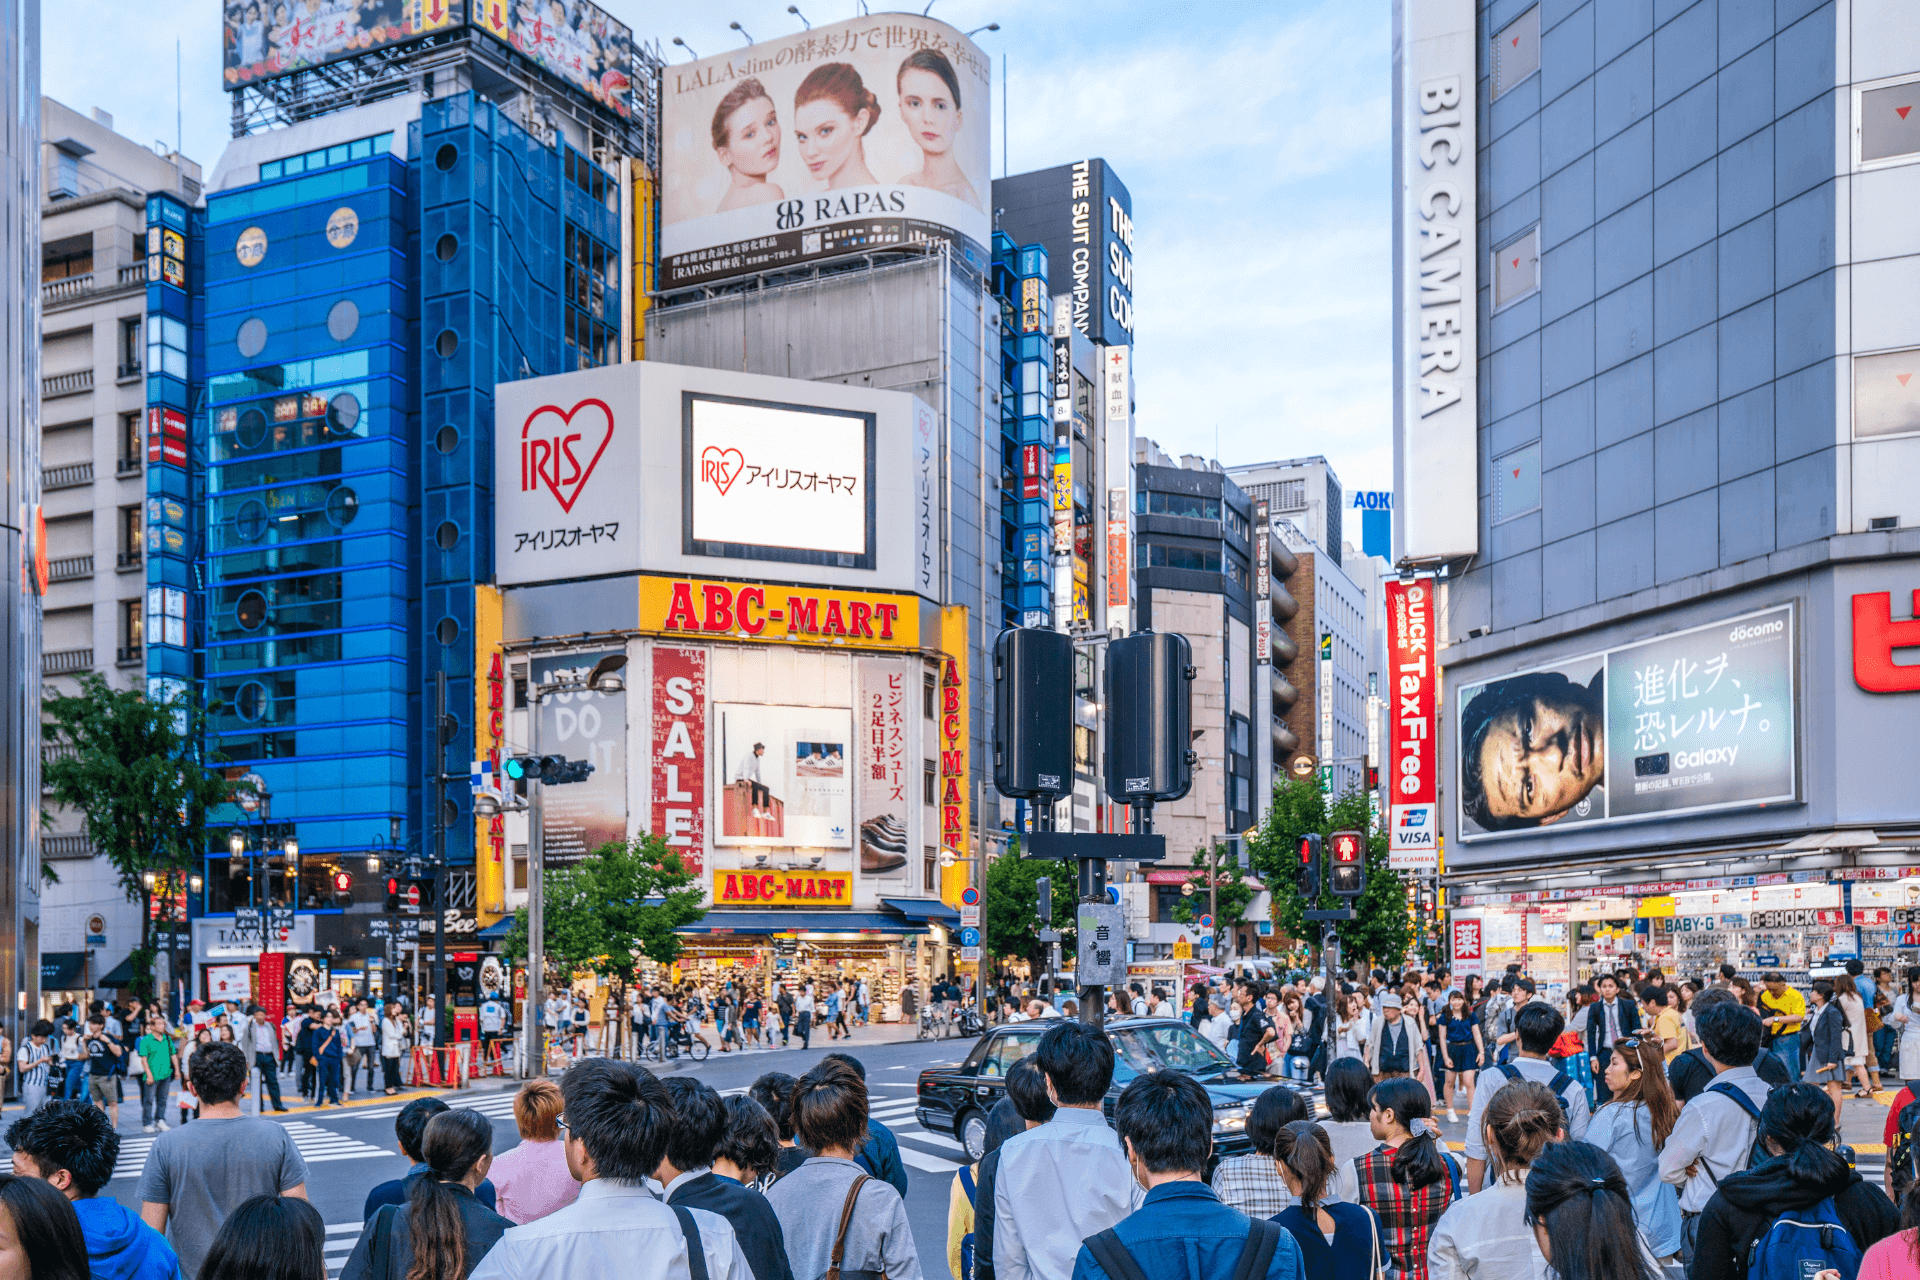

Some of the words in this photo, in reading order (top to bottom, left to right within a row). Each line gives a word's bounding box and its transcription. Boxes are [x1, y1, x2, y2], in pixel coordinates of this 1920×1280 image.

[1419, 75, 1461, 171] BIC
[1072, 159, 1089, 200] THE
[815, 190, 905, 221] RAPAS
[1072, 202, 1090, 245] SUIT
[1419, 181, 1462, 420] CAMERA
[1111, 372, 1123, 400] 献血
[1110, 405, 1123, 414] 9F
[521, 433, 582, 492] IRIS
[701, 458, 730, 485] IRIS
[746, 464, 857, 496] アイリスオーヤマ
[920, 447, 930, 590] アイリスオーヤマ
[1108, 522, 1126, 535] 本
[514, 522, 620, 554] アイリスオーヤマ
[664, 581, 899, 640] ABC-MART
[1407, 586, 1427, 655] QUICK
[1729, 619, 1784, 643] docomo
[1633, 652, 1741, 709] 進化ヲ、
[555, 704, 602, 742] DO
[871, 693, 887, 781] 2足目半額
[888, 672, 904, 802] ビジネスシューズ
[1399, 654, 1427, 795] TaxFree
[1633, 693, 1771, 751] 恐レルナ。
[489, 652, 504, 864] ABC-MRT
[662, 677, 697, 846] SALE
[941, 659, 963, 852] ABC-MART
[1674, 745, 1739, 770] Galaxy
[1398, 831, 1431, 844] VISA
[722, 874, 845, 901] ABC-MART
[1639, 883, 1659, 892] QUICK
[236, 909, 259, 918] MOA
[272, 909, 292, 918] モア
[370, 920, 390, 929] MOA
[1665, 916, 1714, 934] BABY-G
[1750, 909, 1816, 930] G-SHOCK
[1096, 925, 1111, 966] 音響
[1455, 923, 1479, 957] 薬
